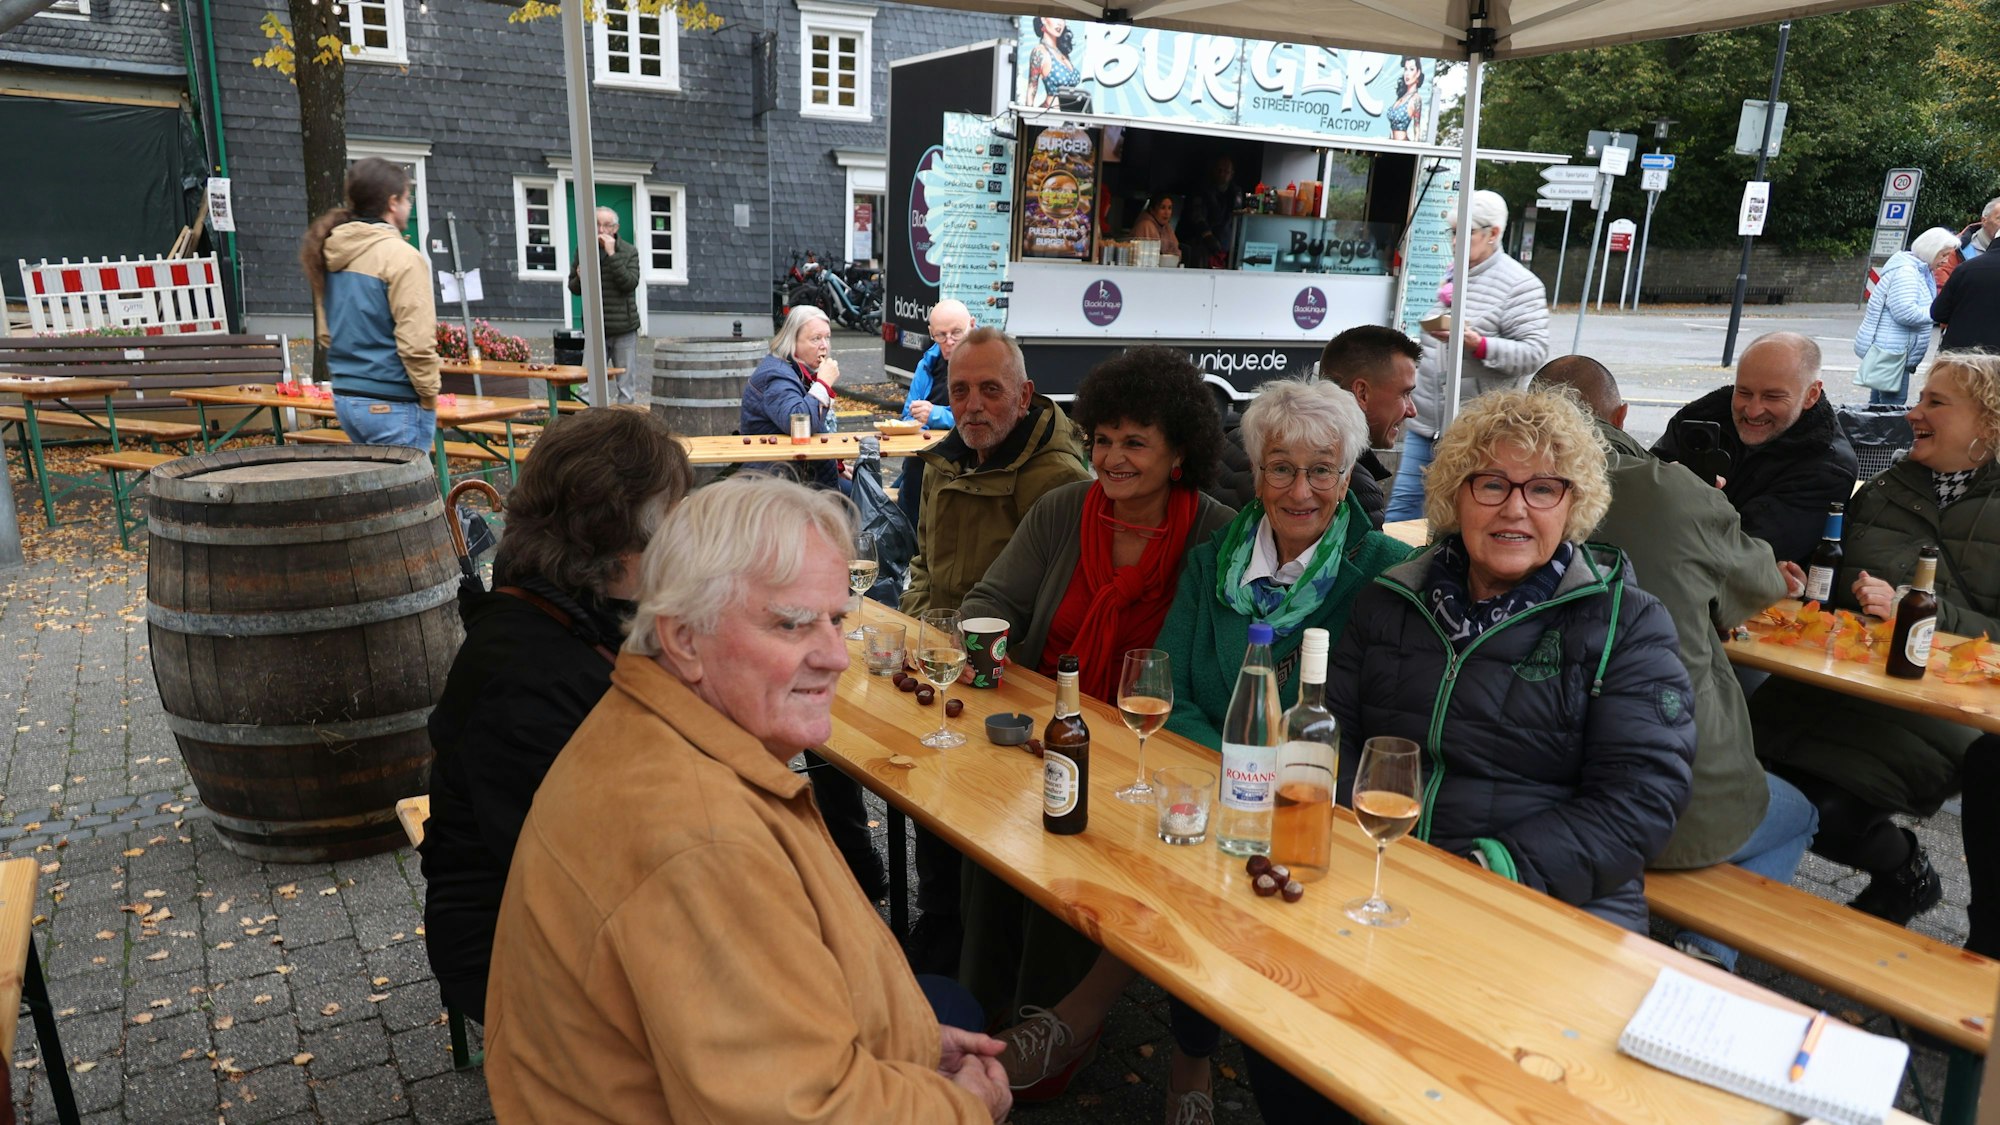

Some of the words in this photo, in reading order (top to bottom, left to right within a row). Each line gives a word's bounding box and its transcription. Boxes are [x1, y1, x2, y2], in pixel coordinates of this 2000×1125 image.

[1081, 24, 1385, 118] BURGER
[1252, 96, 1331, 116] STREETFOOD
[1320, 115, 1372, 133] FACTORY
[1037, 135, 1090, 155] BURGER
[1897, 178, 1909, 187] 20
[1889, 204, 1902, 218] P
[1028, 226, 1057, 237] PULLED
[1058, 227, 1078, 238] PORK
[1035, 237, 1065, 247] BURGER
[1287, 230, 1388, 264] Burger
[1225, 768, 1277, 783] ROMANIS
